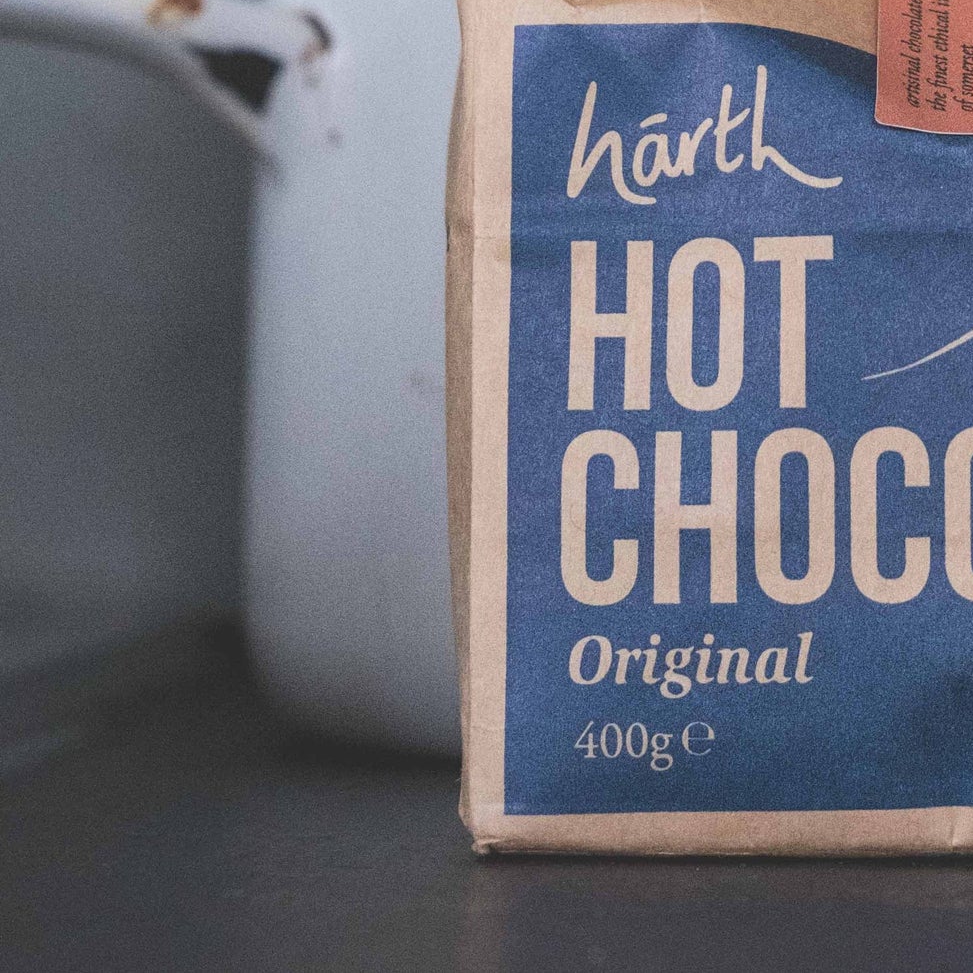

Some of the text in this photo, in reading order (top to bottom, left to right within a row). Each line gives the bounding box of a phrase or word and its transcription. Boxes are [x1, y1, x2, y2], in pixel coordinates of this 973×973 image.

[927, 10, 950, 53] ethical
[900, 53, 922, 109] artisinal
[926, 55, 954, 92] finest
[926, 93, 948, 112] the
[567, 234, 834, 412] HOT
[568, 631, 815, 700] Original
[573, 720, 674, 772] 400g
